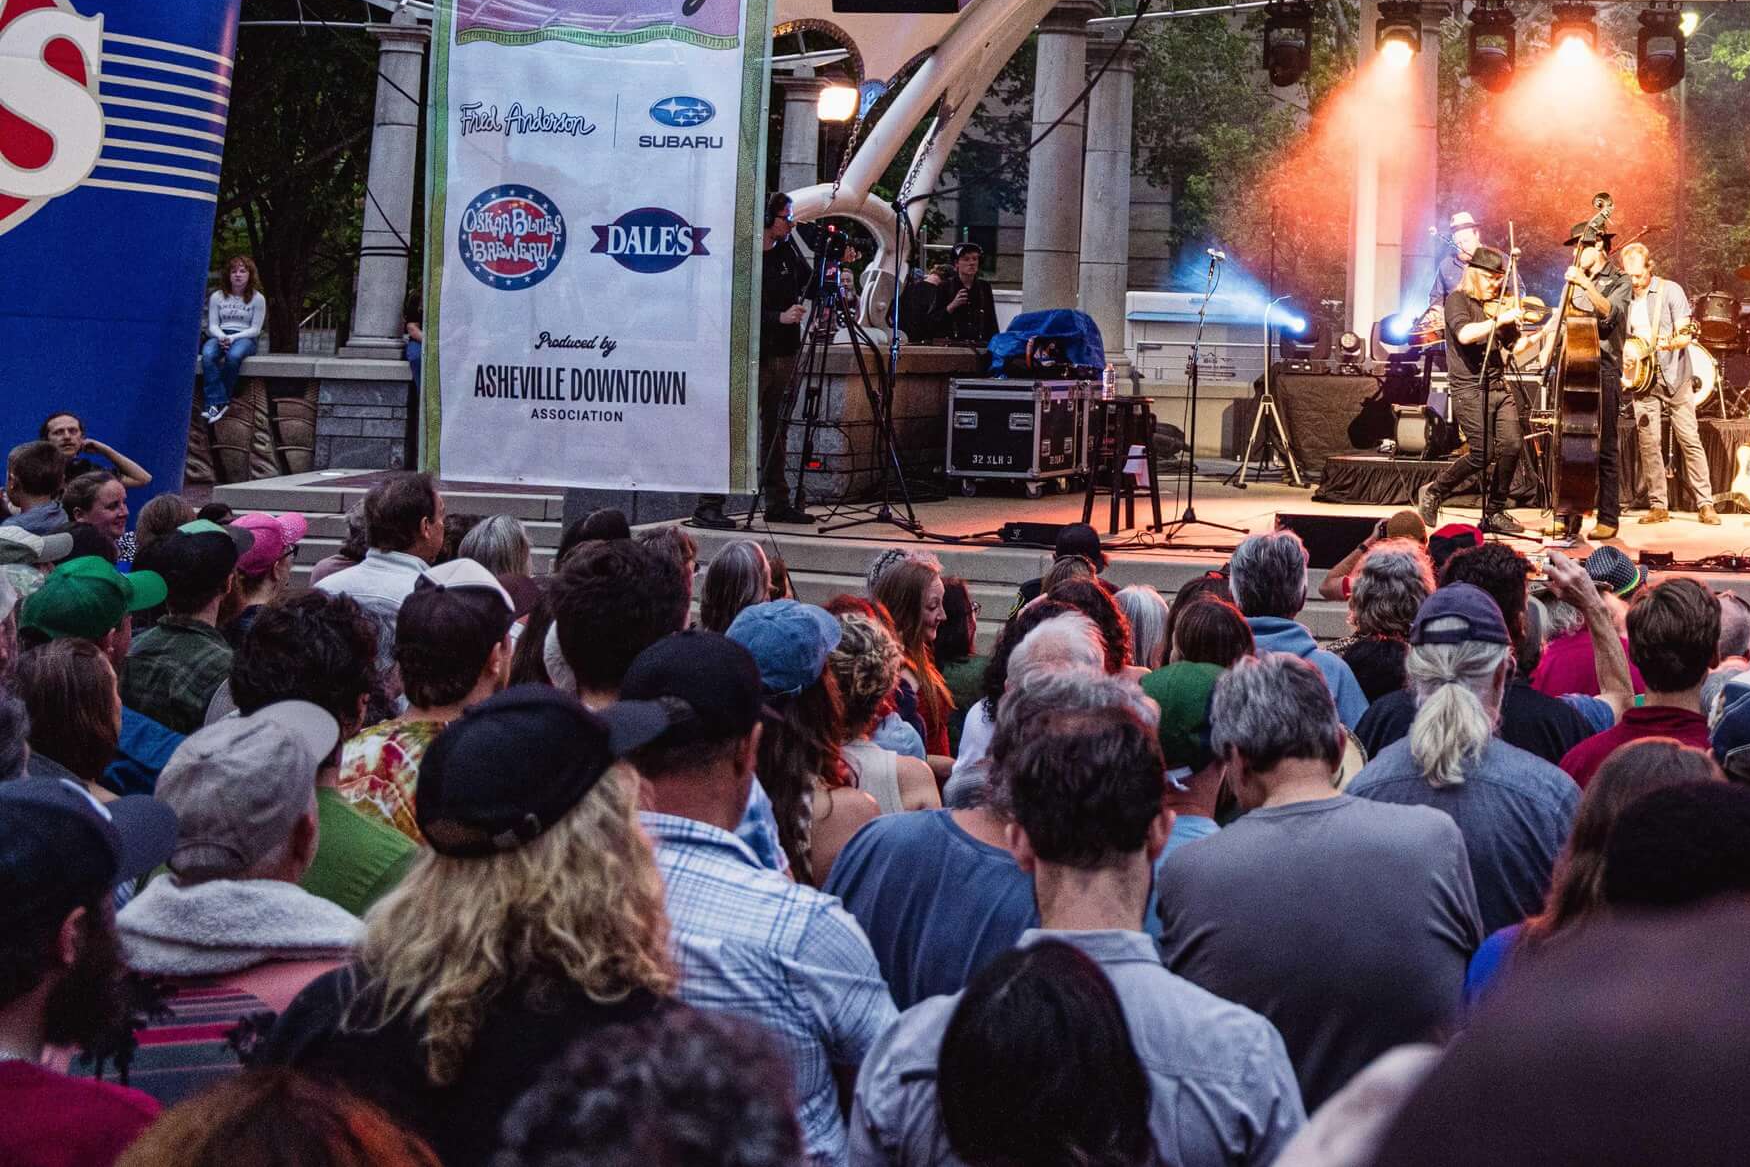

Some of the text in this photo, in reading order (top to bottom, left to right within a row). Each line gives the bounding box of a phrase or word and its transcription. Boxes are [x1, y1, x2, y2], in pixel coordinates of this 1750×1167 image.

[459, 101, 596, 137] Fred Anderson
[638, 136, 724, 149] SUBARU
[607, 224, 695, 256] DALE'S
[534, 331, 617, 358] Produced by
[474, 364, 687, 406] ASHEVILLE DOWNTOWN
[530, 407, 624, 423] ASSOCIATION
[972, 454, 984, 464] 32
